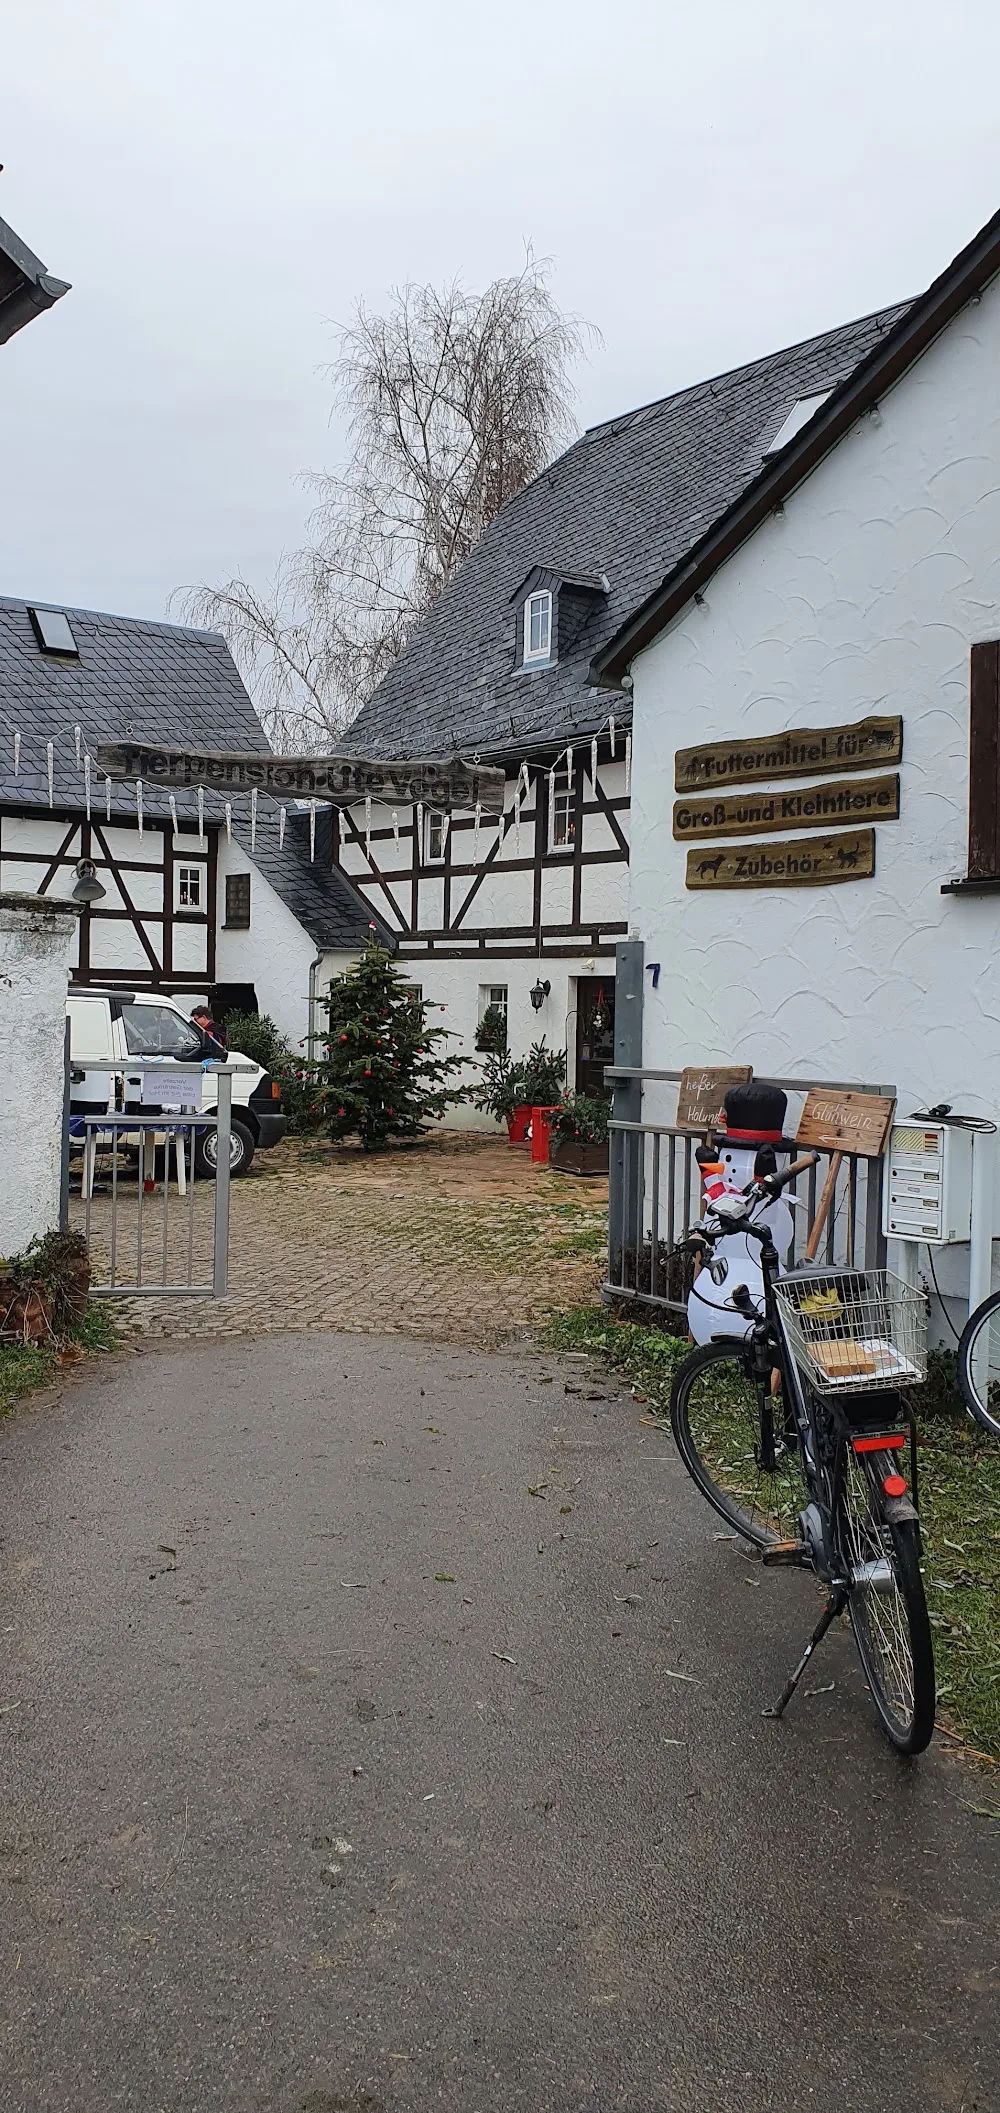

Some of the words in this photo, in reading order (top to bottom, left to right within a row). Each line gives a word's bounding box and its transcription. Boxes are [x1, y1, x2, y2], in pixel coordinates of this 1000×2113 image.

[121, 745, 316, 791] Tierpension
[704, 738, 827, 778] Futtermittel
[837, 734, 868, 757] für
[782, 790, 891, 818] Kleintiere
[734, 853, 823, 876] Zubehör
[645, 963, 661, 988] 7
[687, 1105, 725, 1125] Holund
[812, 1101, 874, 1130] Glühwein
